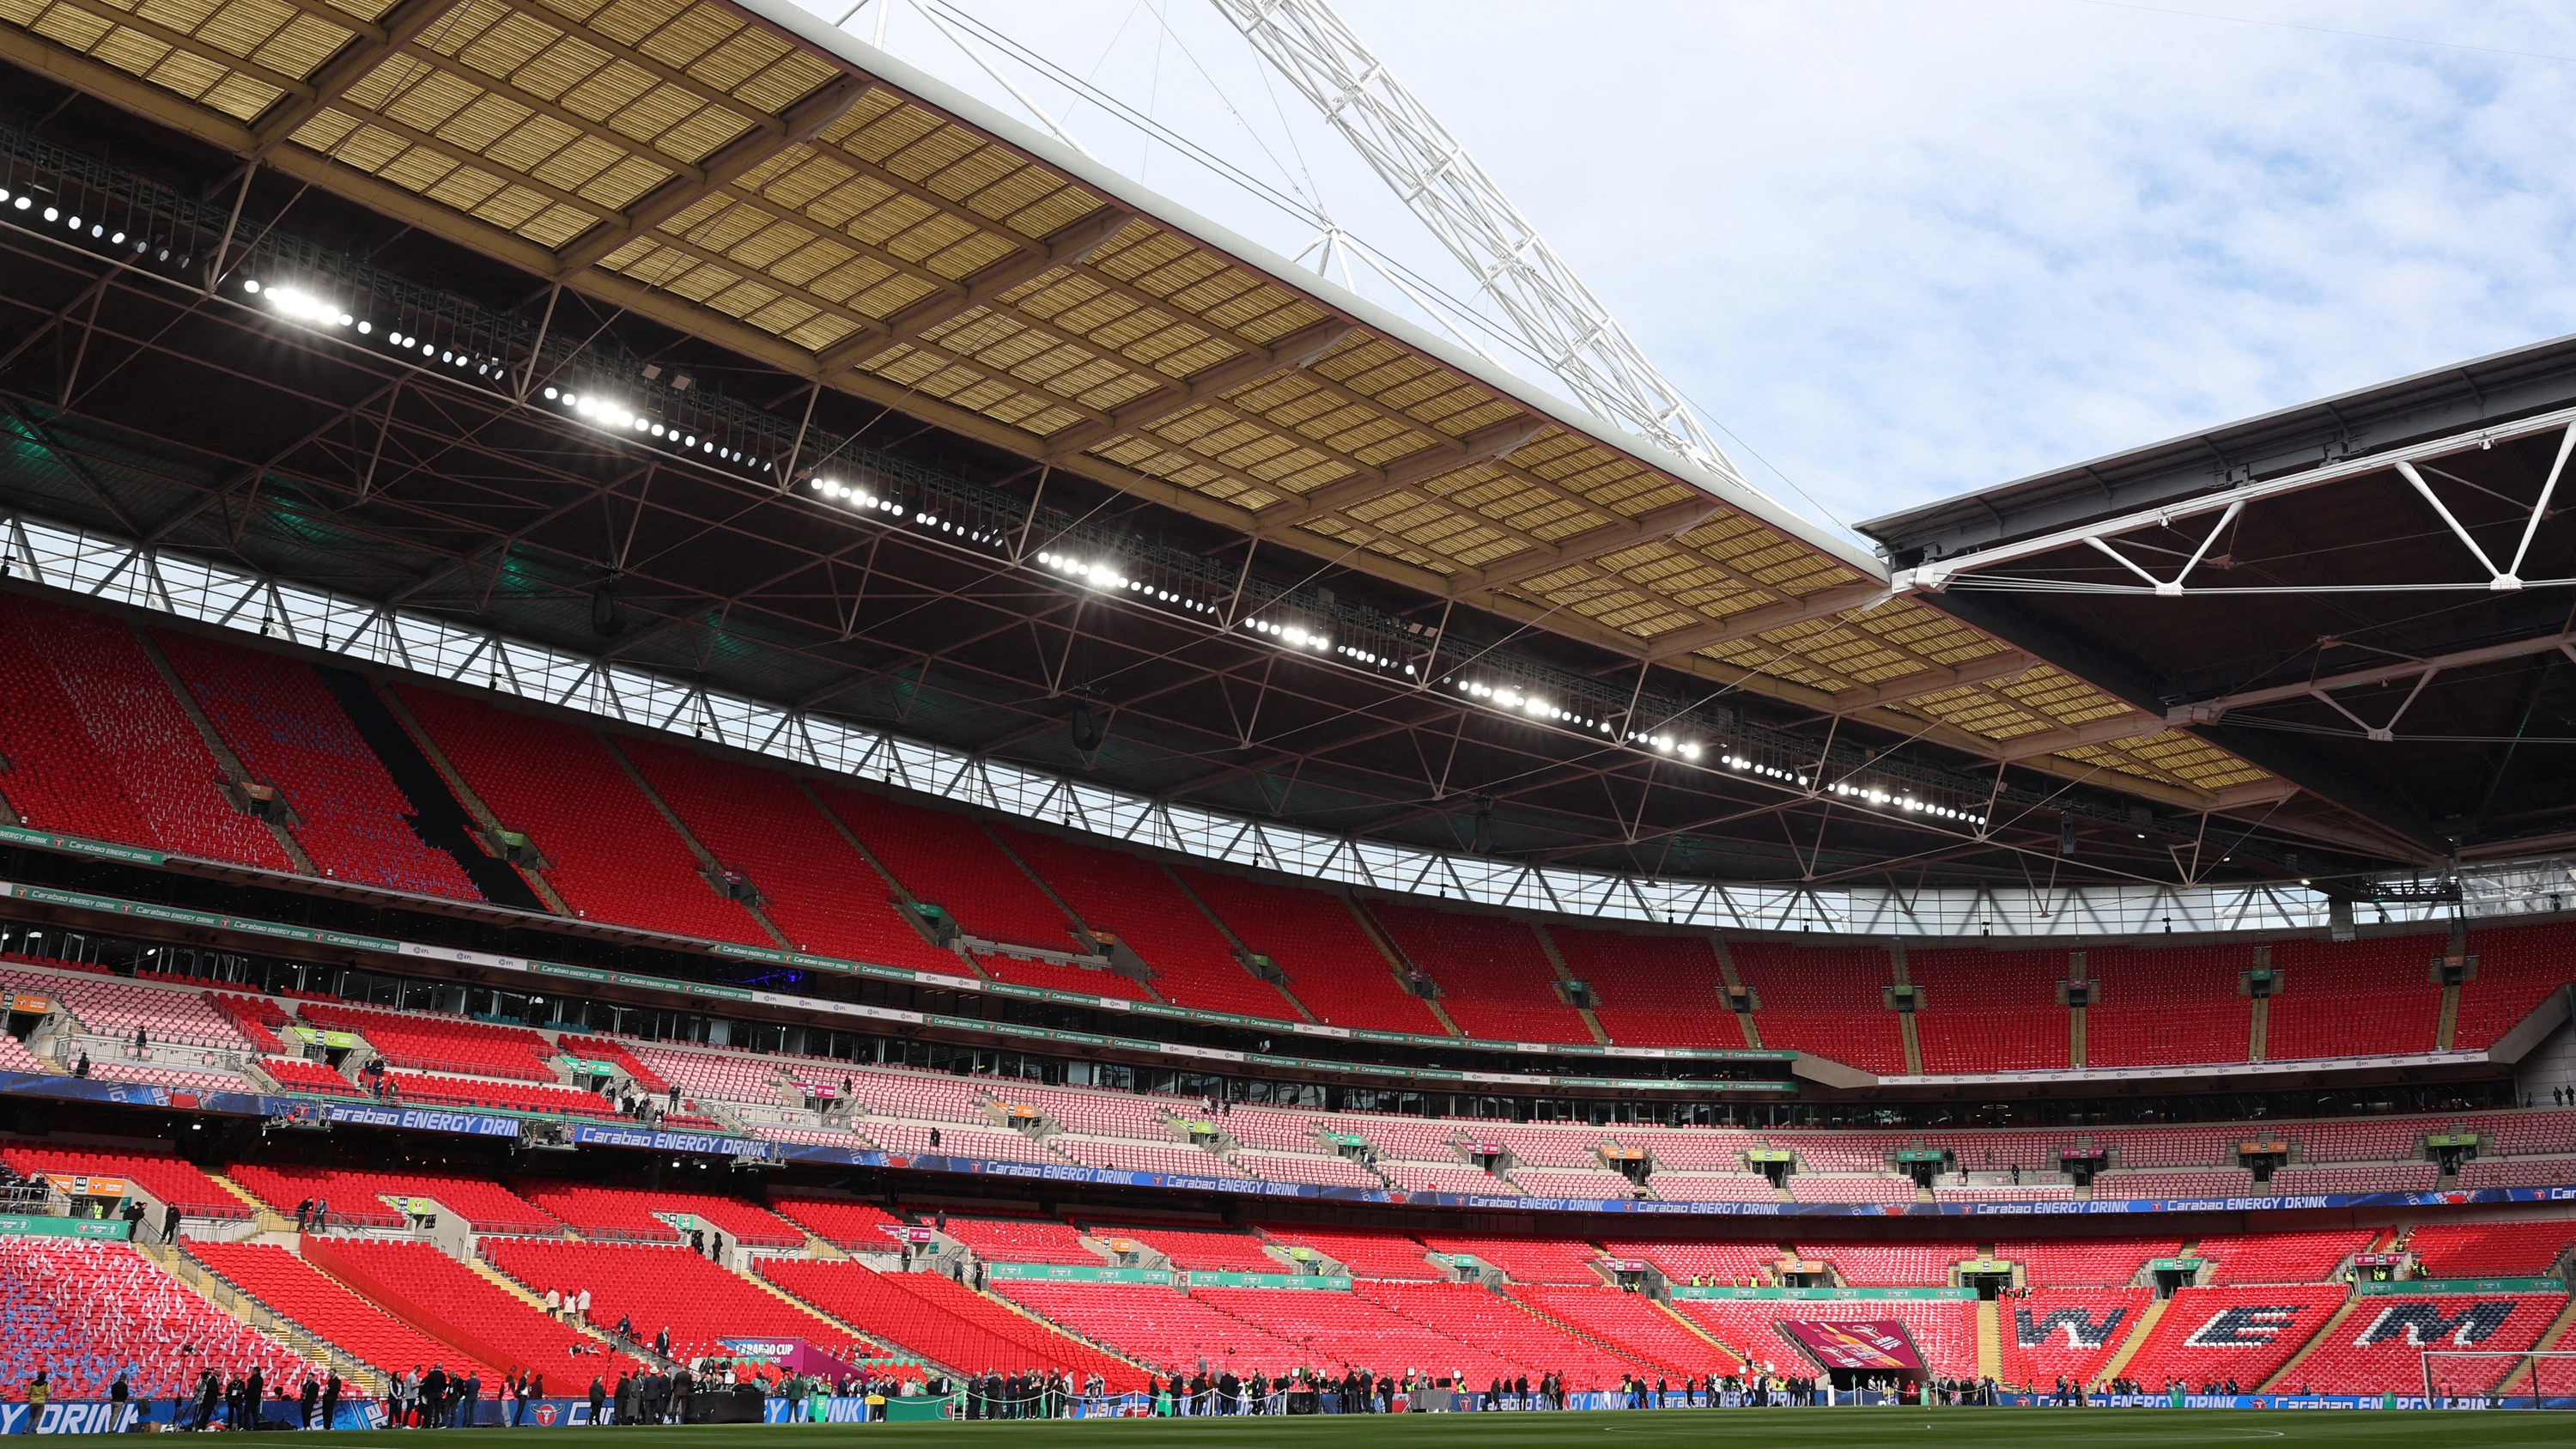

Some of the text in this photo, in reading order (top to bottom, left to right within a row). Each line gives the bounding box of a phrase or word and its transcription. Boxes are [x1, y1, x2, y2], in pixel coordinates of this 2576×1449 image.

[26, 835, 48, 844] DRINK
[69, 841, 152, 861] Carabao ENERGY DRINK
[32, 890, 67, 902] Carabao
[69, 897, 94, 906] ENERGY
[136, 906, 170, 917] Carabao
[171, 913, 196, 921] ENERGY
[234, 921, 266, 931] Carabao
[268, 927, 291, 935] ENERGY
[327, 935, 357, 945] Carabao
[359, 940, 380, 949] ENERGY
[723, 946, 747, 955] Carabao
[794, 956, 817, 965] Carabao
[542, 965, 569, 974] Carabao
[570, 970, 589, 978] ENERGY
[402, 1111, 477, 1132] ENERGY
[480, 1119, 518, 1137] DRIN
[581, 1128, 652, 1147] Carabao
[654, 1133, 719, 1153] ENERGY
[986, 1162, 1134, 1184] Carabao ENERGY DRINK
[1166, 1176, 1300, 1196] Carabao ENERGY DRINK
[1469, 1196, 1605, 1212] Carabao ENERGY DRINK
[1637, 1202, 1780, 1215] Carabao ENERGY DRINK
[1977, 1201, 2130, 1214] Carabao ENERGY DRINK
[2167, 1196, 2328, 1211] Carabao ENERGY DRINK
[777, 1344, 794, 1355] CUP
[2185, 1396, 2238, 1408] DRINK
